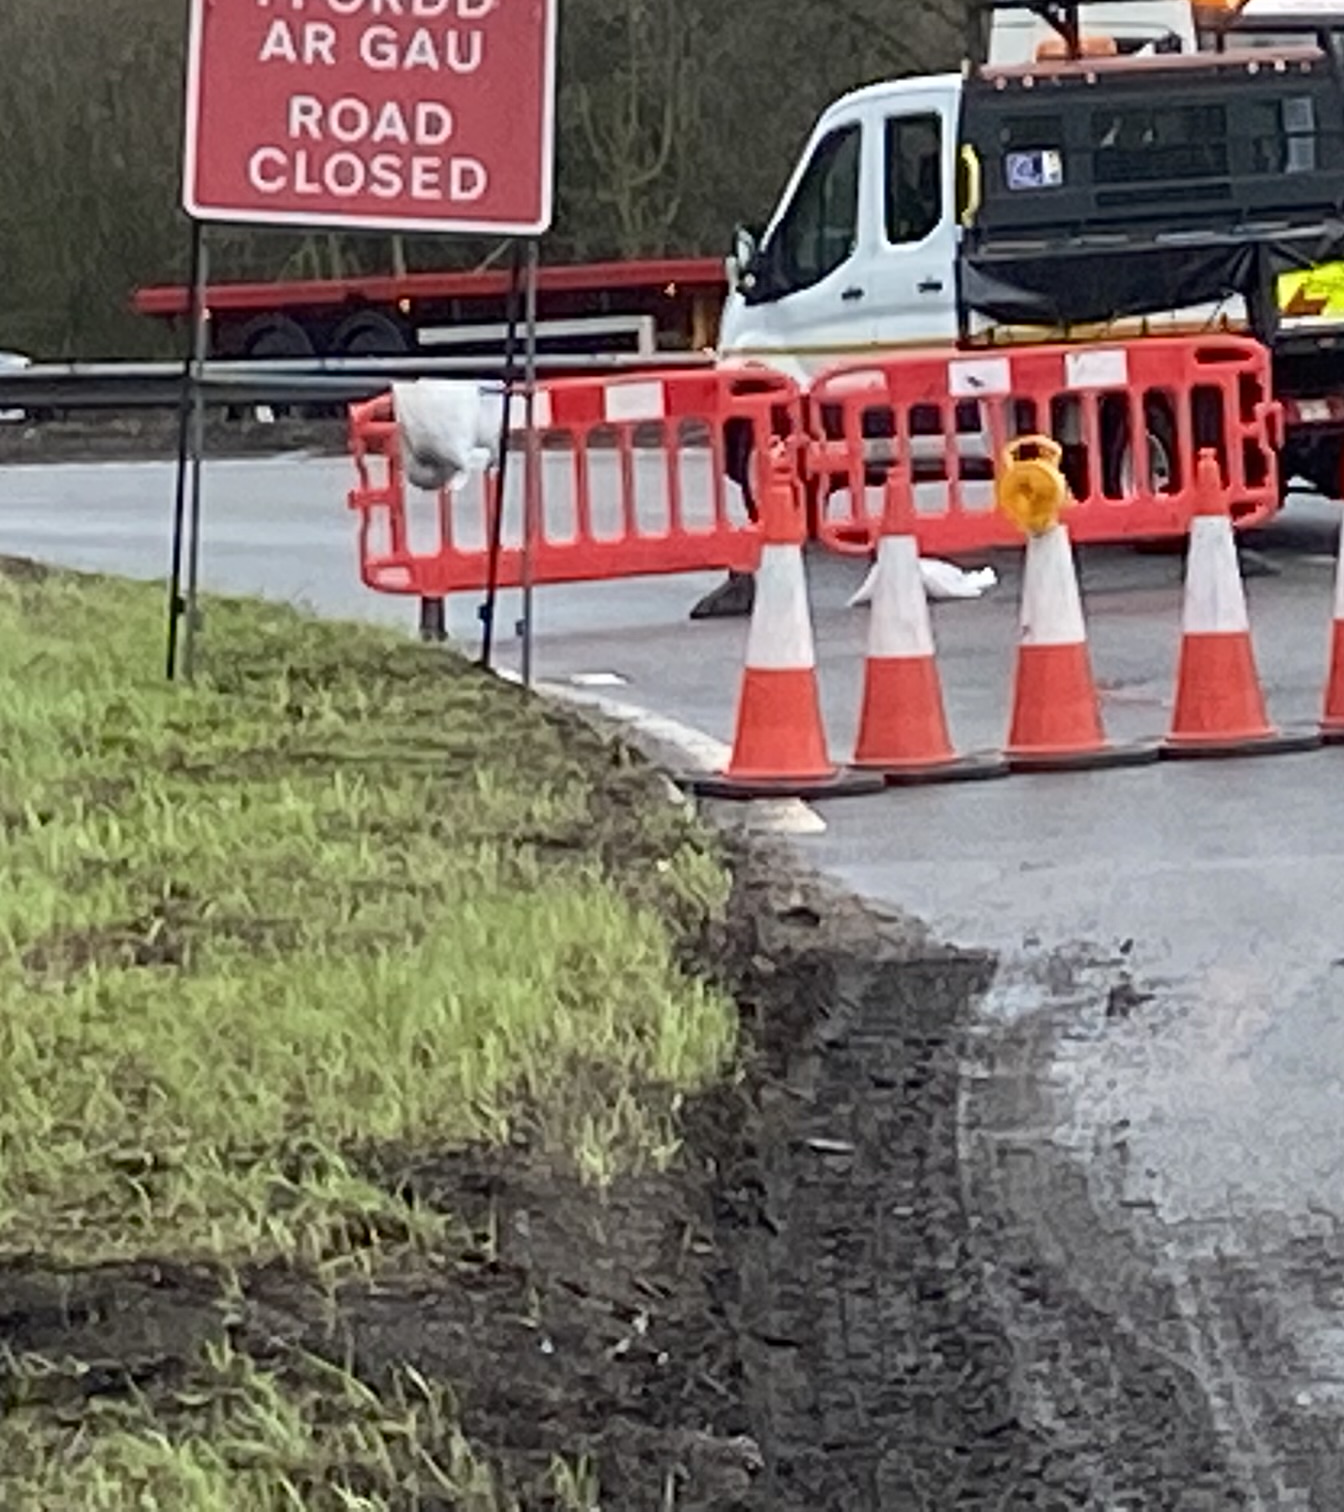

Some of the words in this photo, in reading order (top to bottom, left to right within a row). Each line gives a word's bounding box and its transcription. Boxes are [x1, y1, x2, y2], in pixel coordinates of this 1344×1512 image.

[258, 19, 336, 65] AR
[360, 25, 483, 73] GAU
[289, 95, 453, 146] ROAD
[249, 147, 488, 201] CLOSED
